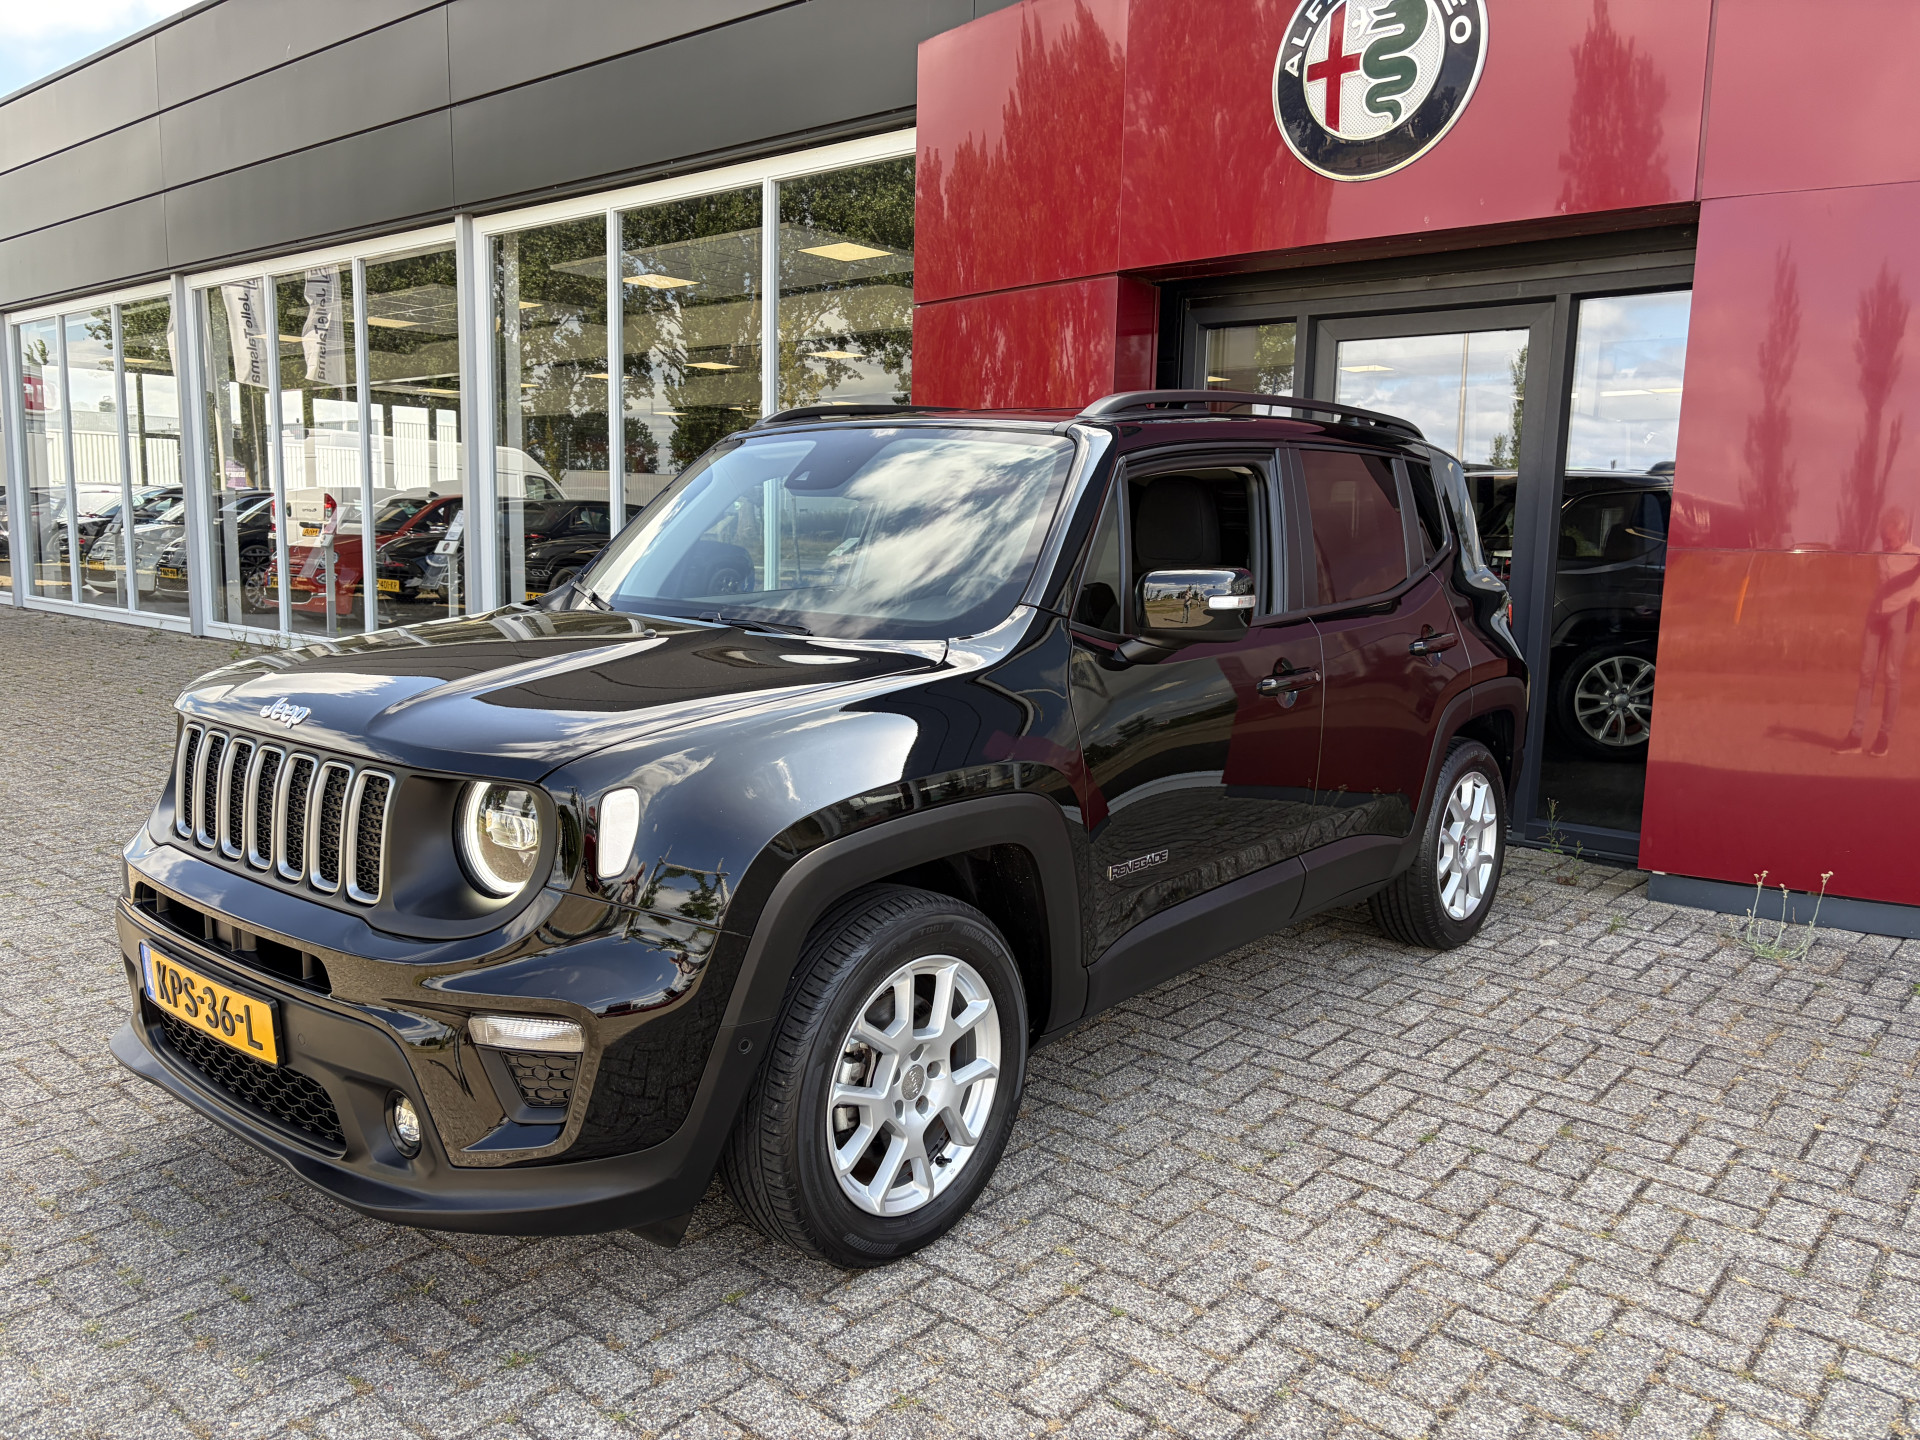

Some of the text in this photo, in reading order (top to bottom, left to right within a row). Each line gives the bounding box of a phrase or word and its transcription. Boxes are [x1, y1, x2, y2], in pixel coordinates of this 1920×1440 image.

[1285, 0, 1333, 77] ALF
[260, 697, 312, 729] Jeep
[1108, 849, 1168, 881] RENEGADE
[156, 961, 263, 1050] KPS-36-L
